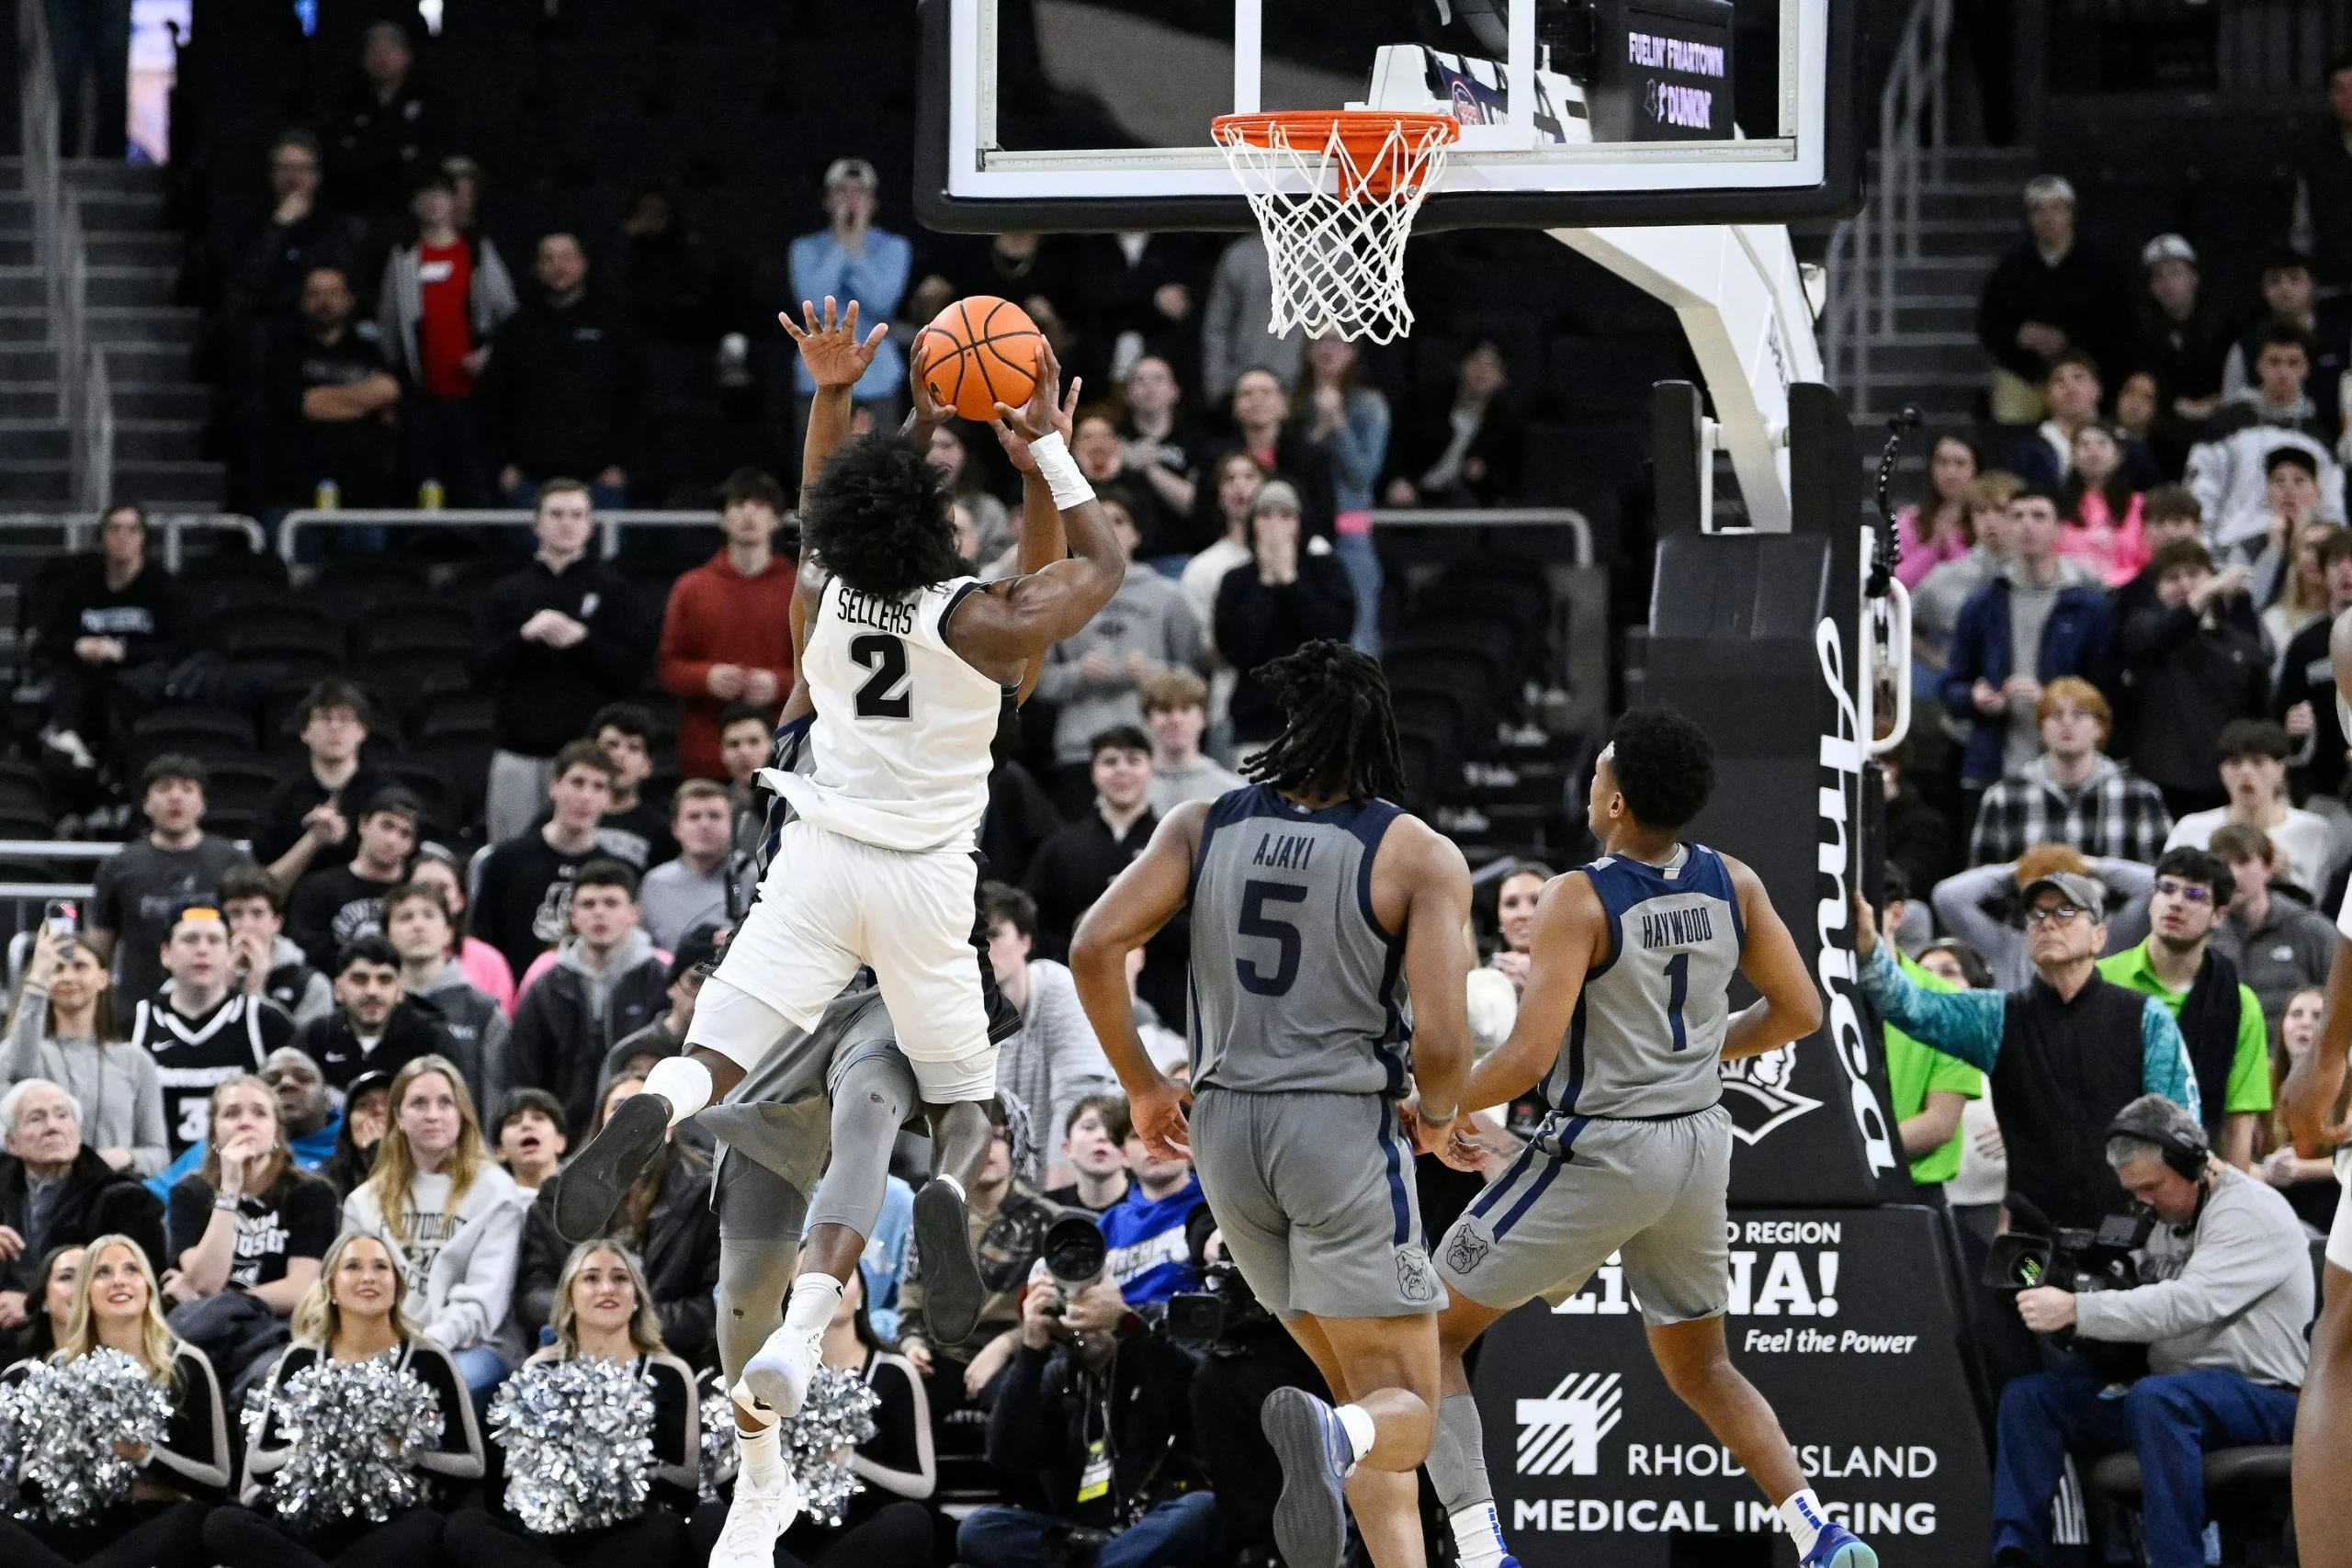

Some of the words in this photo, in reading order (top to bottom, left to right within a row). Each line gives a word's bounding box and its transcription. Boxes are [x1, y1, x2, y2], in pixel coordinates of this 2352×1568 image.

[837, 587, 917, 635] SELLERS
[847, 630, 913, 721] 2
[1252, 833, 1315, 870] AJAYI
[1815, 616, 1896, 1179] Amica
[1236, 879, 1308, 998] 5
[1642, 907, 1713, 949] HAYWOOD
[1663, 953, 1689, 1052] 1
[1746, 1221, 1841, 1245] REGION
[1550, 1248, 1839, 1317] iNA!
[1744, 1328, 1793, 1353] Feel
[1797, 1327, 1837, 1353] the
[1839, 1329, 1918, 1354] Power
[1628, 1443, 1747, 1477] RHOD
[1513, 1498, 1720, 1532] MEDICAL
[1734, 1500, 1937, 1536] IMGING
